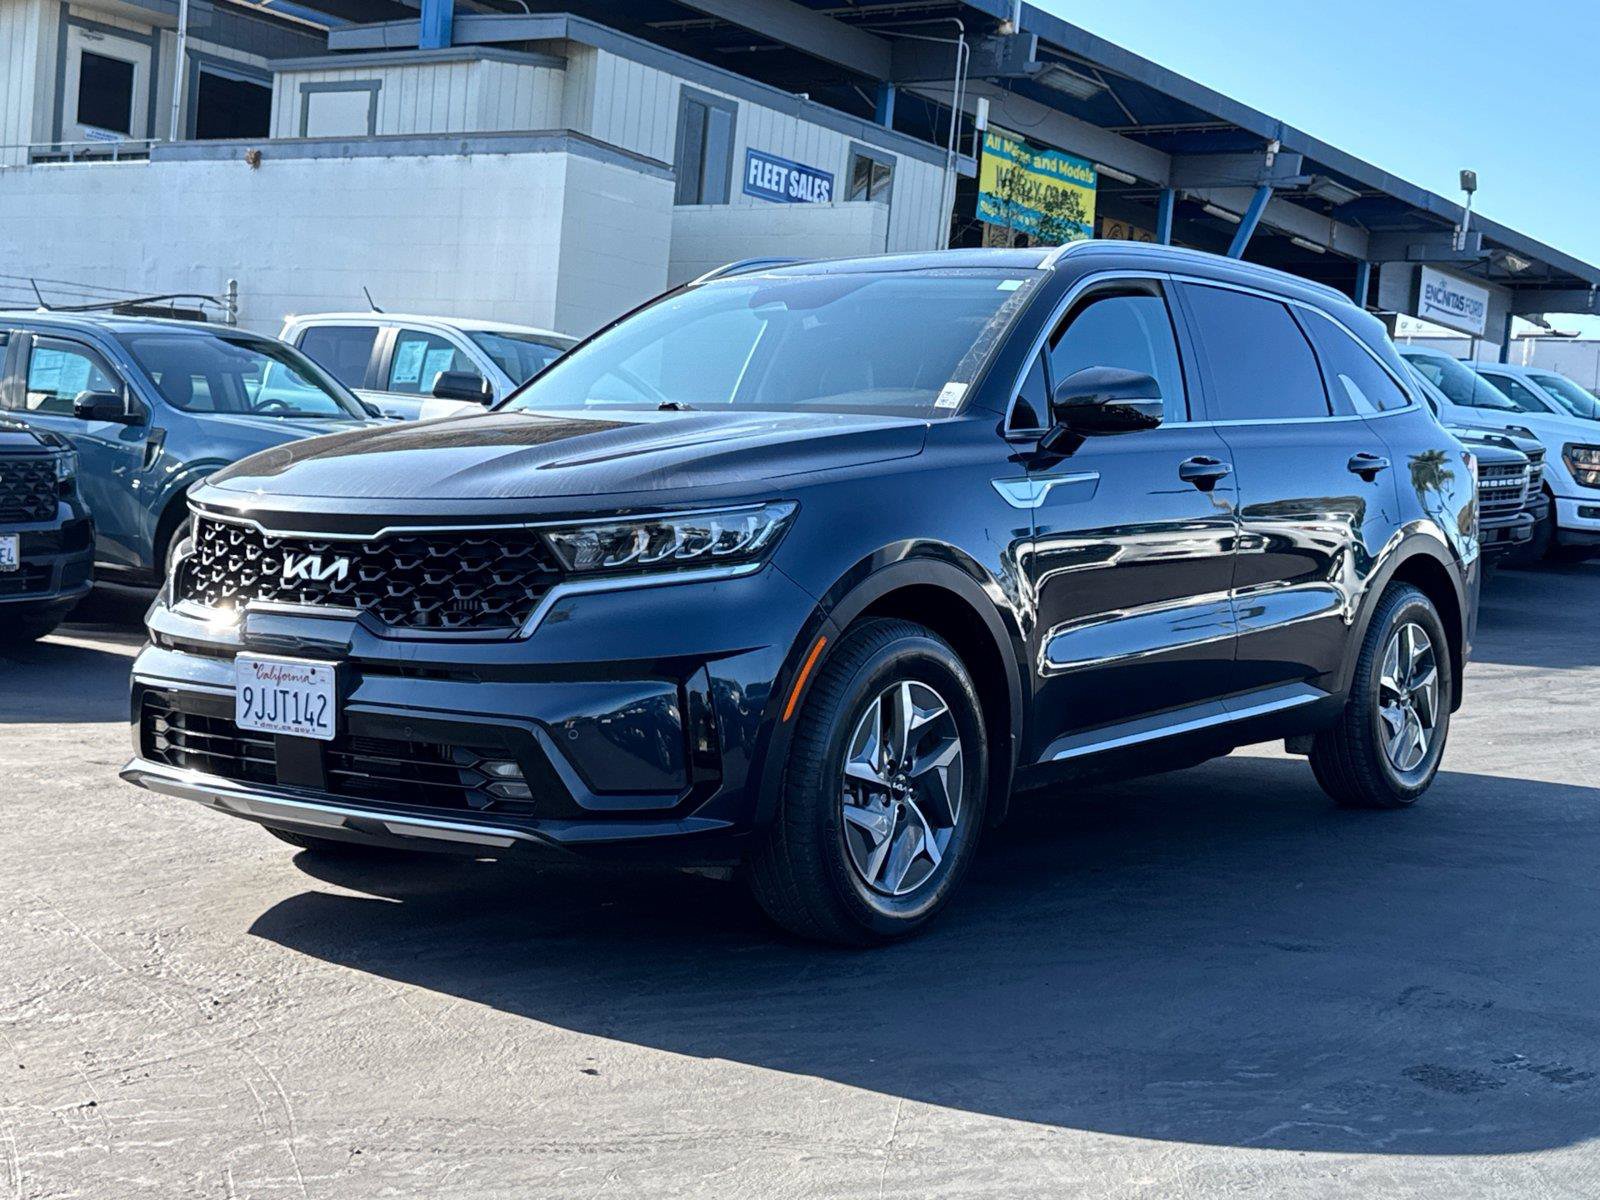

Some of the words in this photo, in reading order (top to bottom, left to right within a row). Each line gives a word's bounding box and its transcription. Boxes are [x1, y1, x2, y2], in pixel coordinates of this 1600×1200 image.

[986, 133, 1001, 150] All
[1033, 155, 1058, 172] and
[1059, 159, 1095, 184] Models
[748, 157, 789, 194] FLEET
[788, 170, 830, 203] SALES
[1478, 478, 1522, 488] RONCO
[282, 552, 350, 582] KIA
[256, 663, 316, 687] California
[243, 686, 328, 729] 9JJT142
